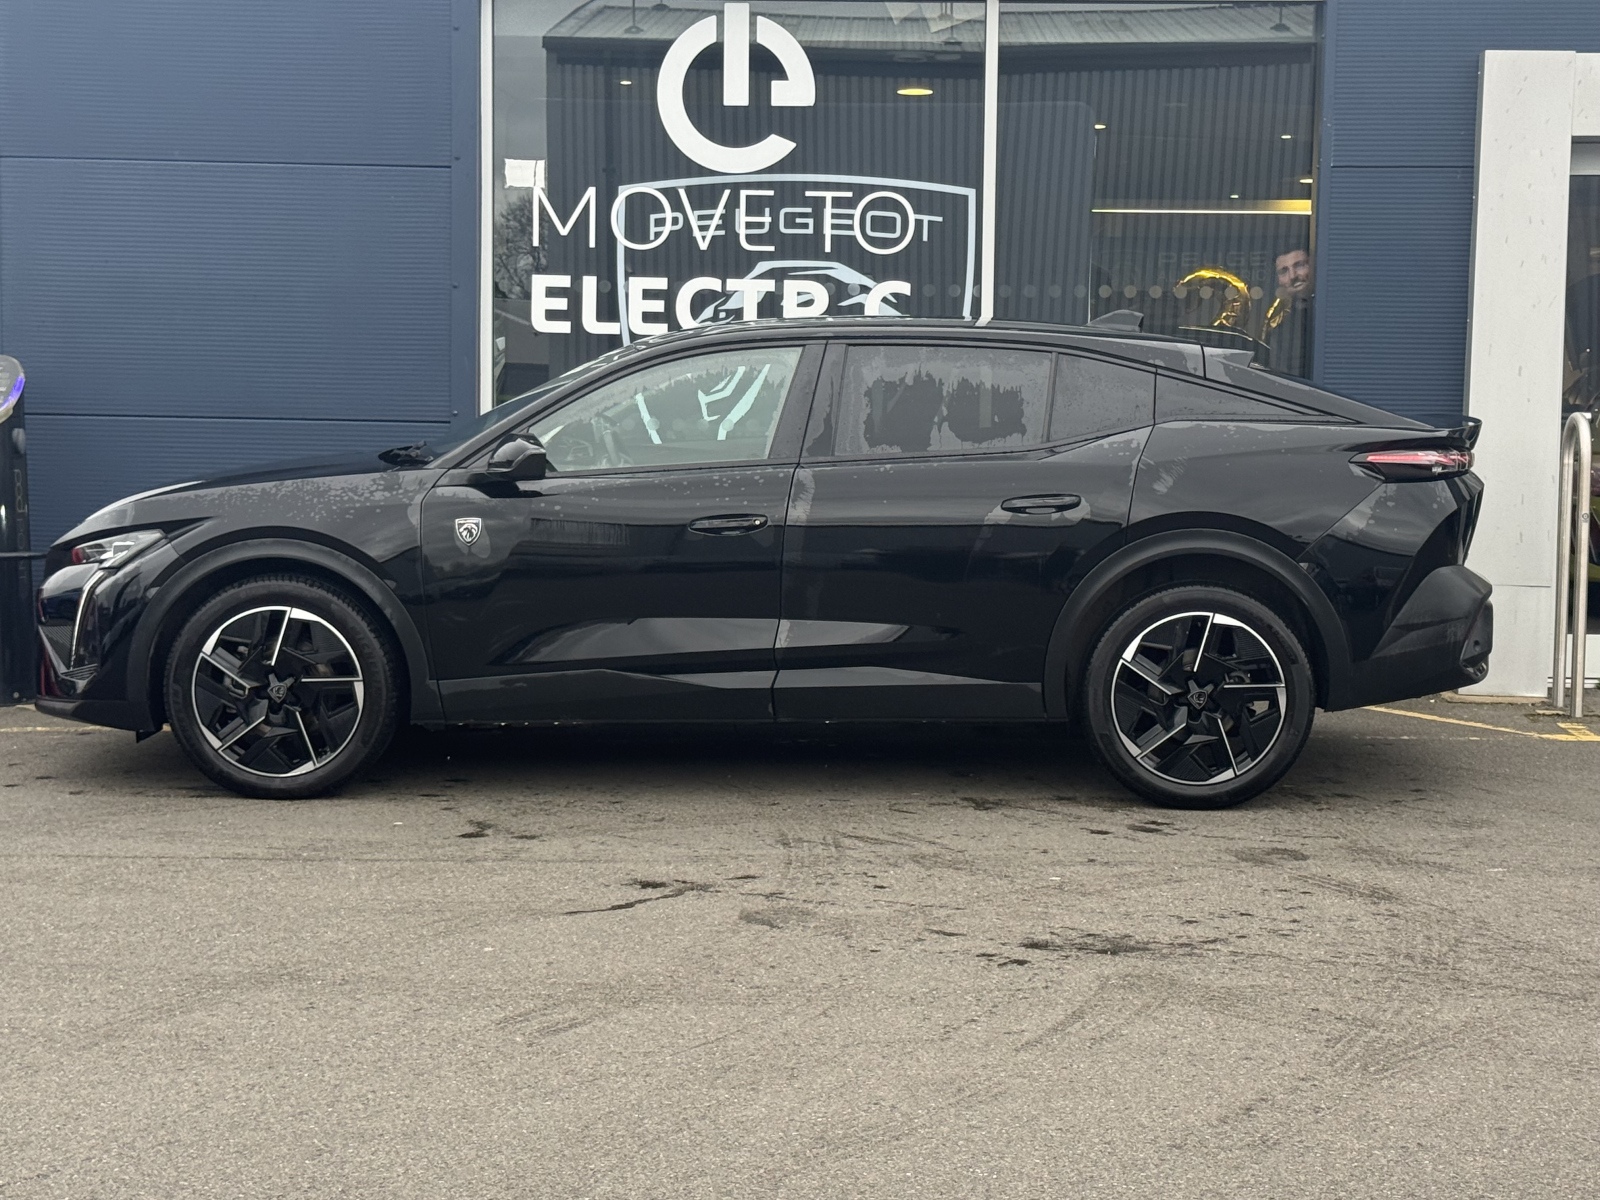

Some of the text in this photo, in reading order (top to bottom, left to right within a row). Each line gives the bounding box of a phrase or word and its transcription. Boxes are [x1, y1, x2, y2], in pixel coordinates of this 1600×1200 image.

[531, 186, 916, 255] MOVE TO
[649, 207, 943, 243] PEUGEOT
